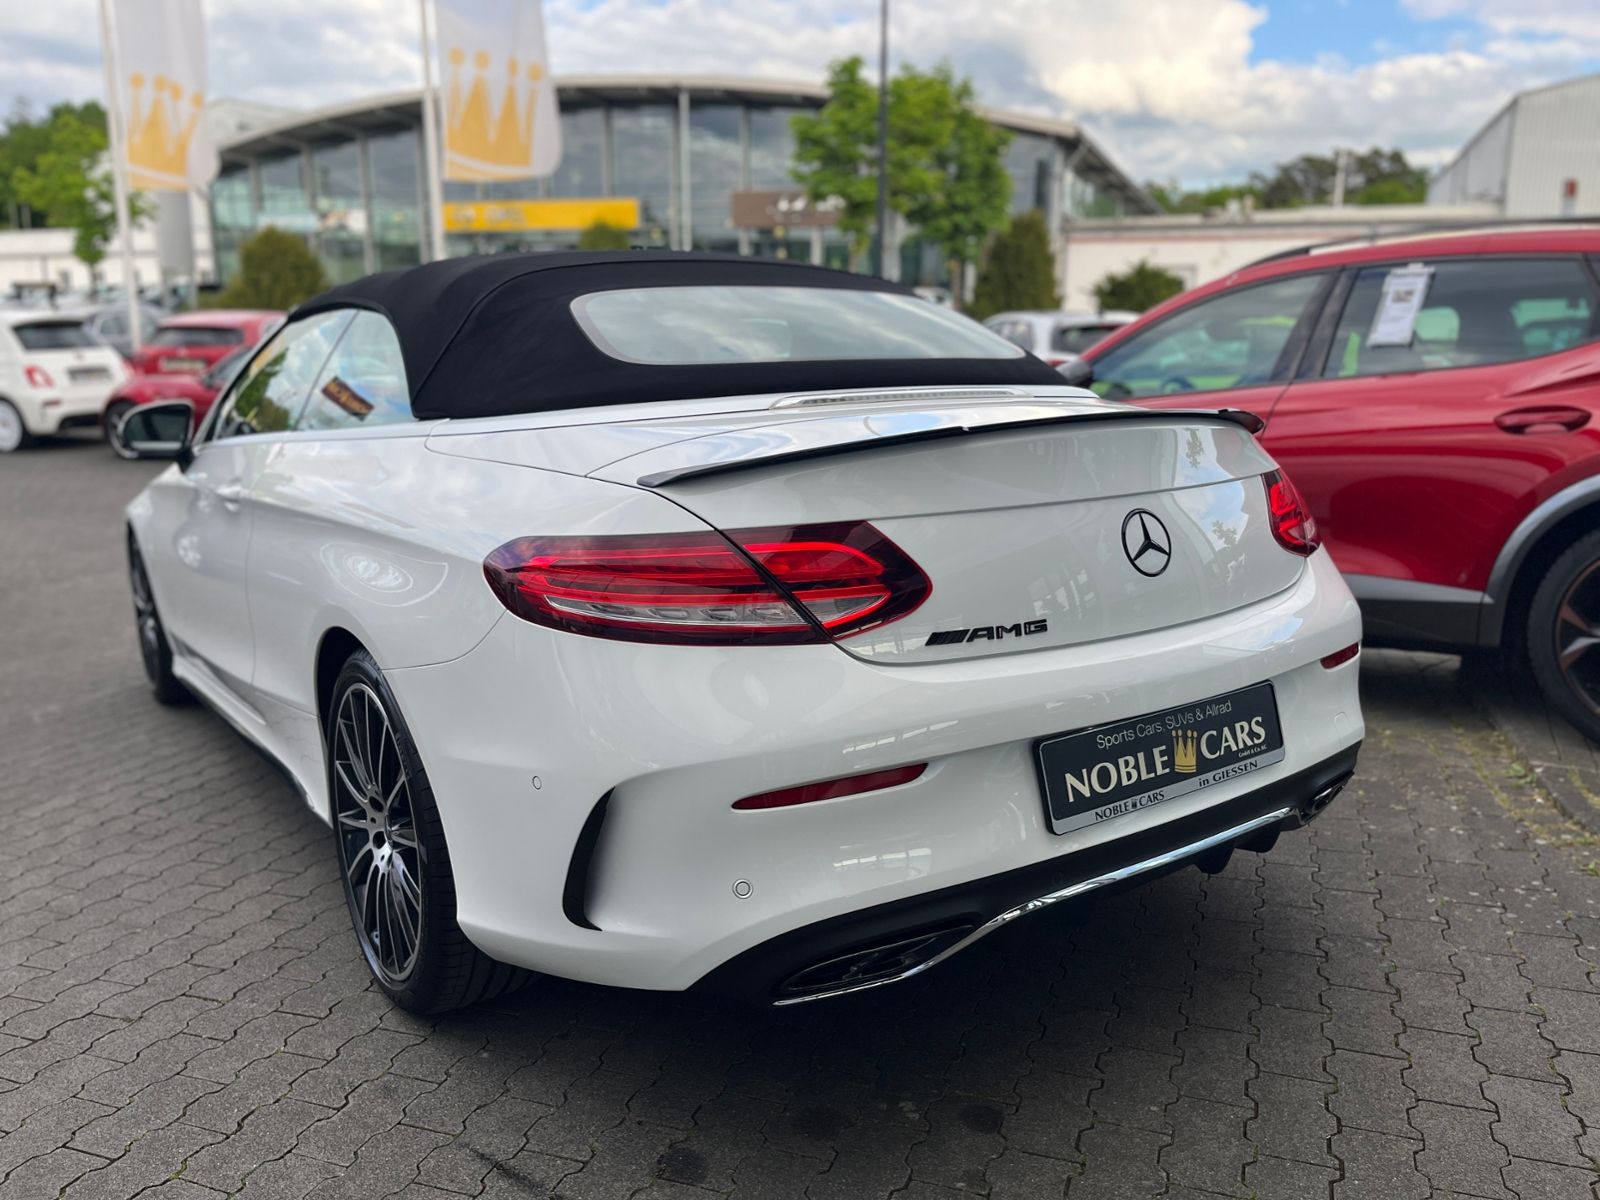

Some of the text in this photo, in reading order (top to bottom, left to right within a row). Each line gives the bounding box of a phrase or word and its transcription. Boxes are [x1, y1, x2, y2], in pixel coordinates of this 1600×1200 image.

[965, 619, 1048, 643] AMG
[1096, 729, 1135, 750] Sports
[1165, 711, 1194, 730] SUVs
[1195, 708, 1204, 720] &
[1205, 700, 1232, 719] Allrad
[1064, 716, 1266, 803] NOBLE CARS
[1095, 760, 1258, 821] NOBLE CARS in GIESSEN
